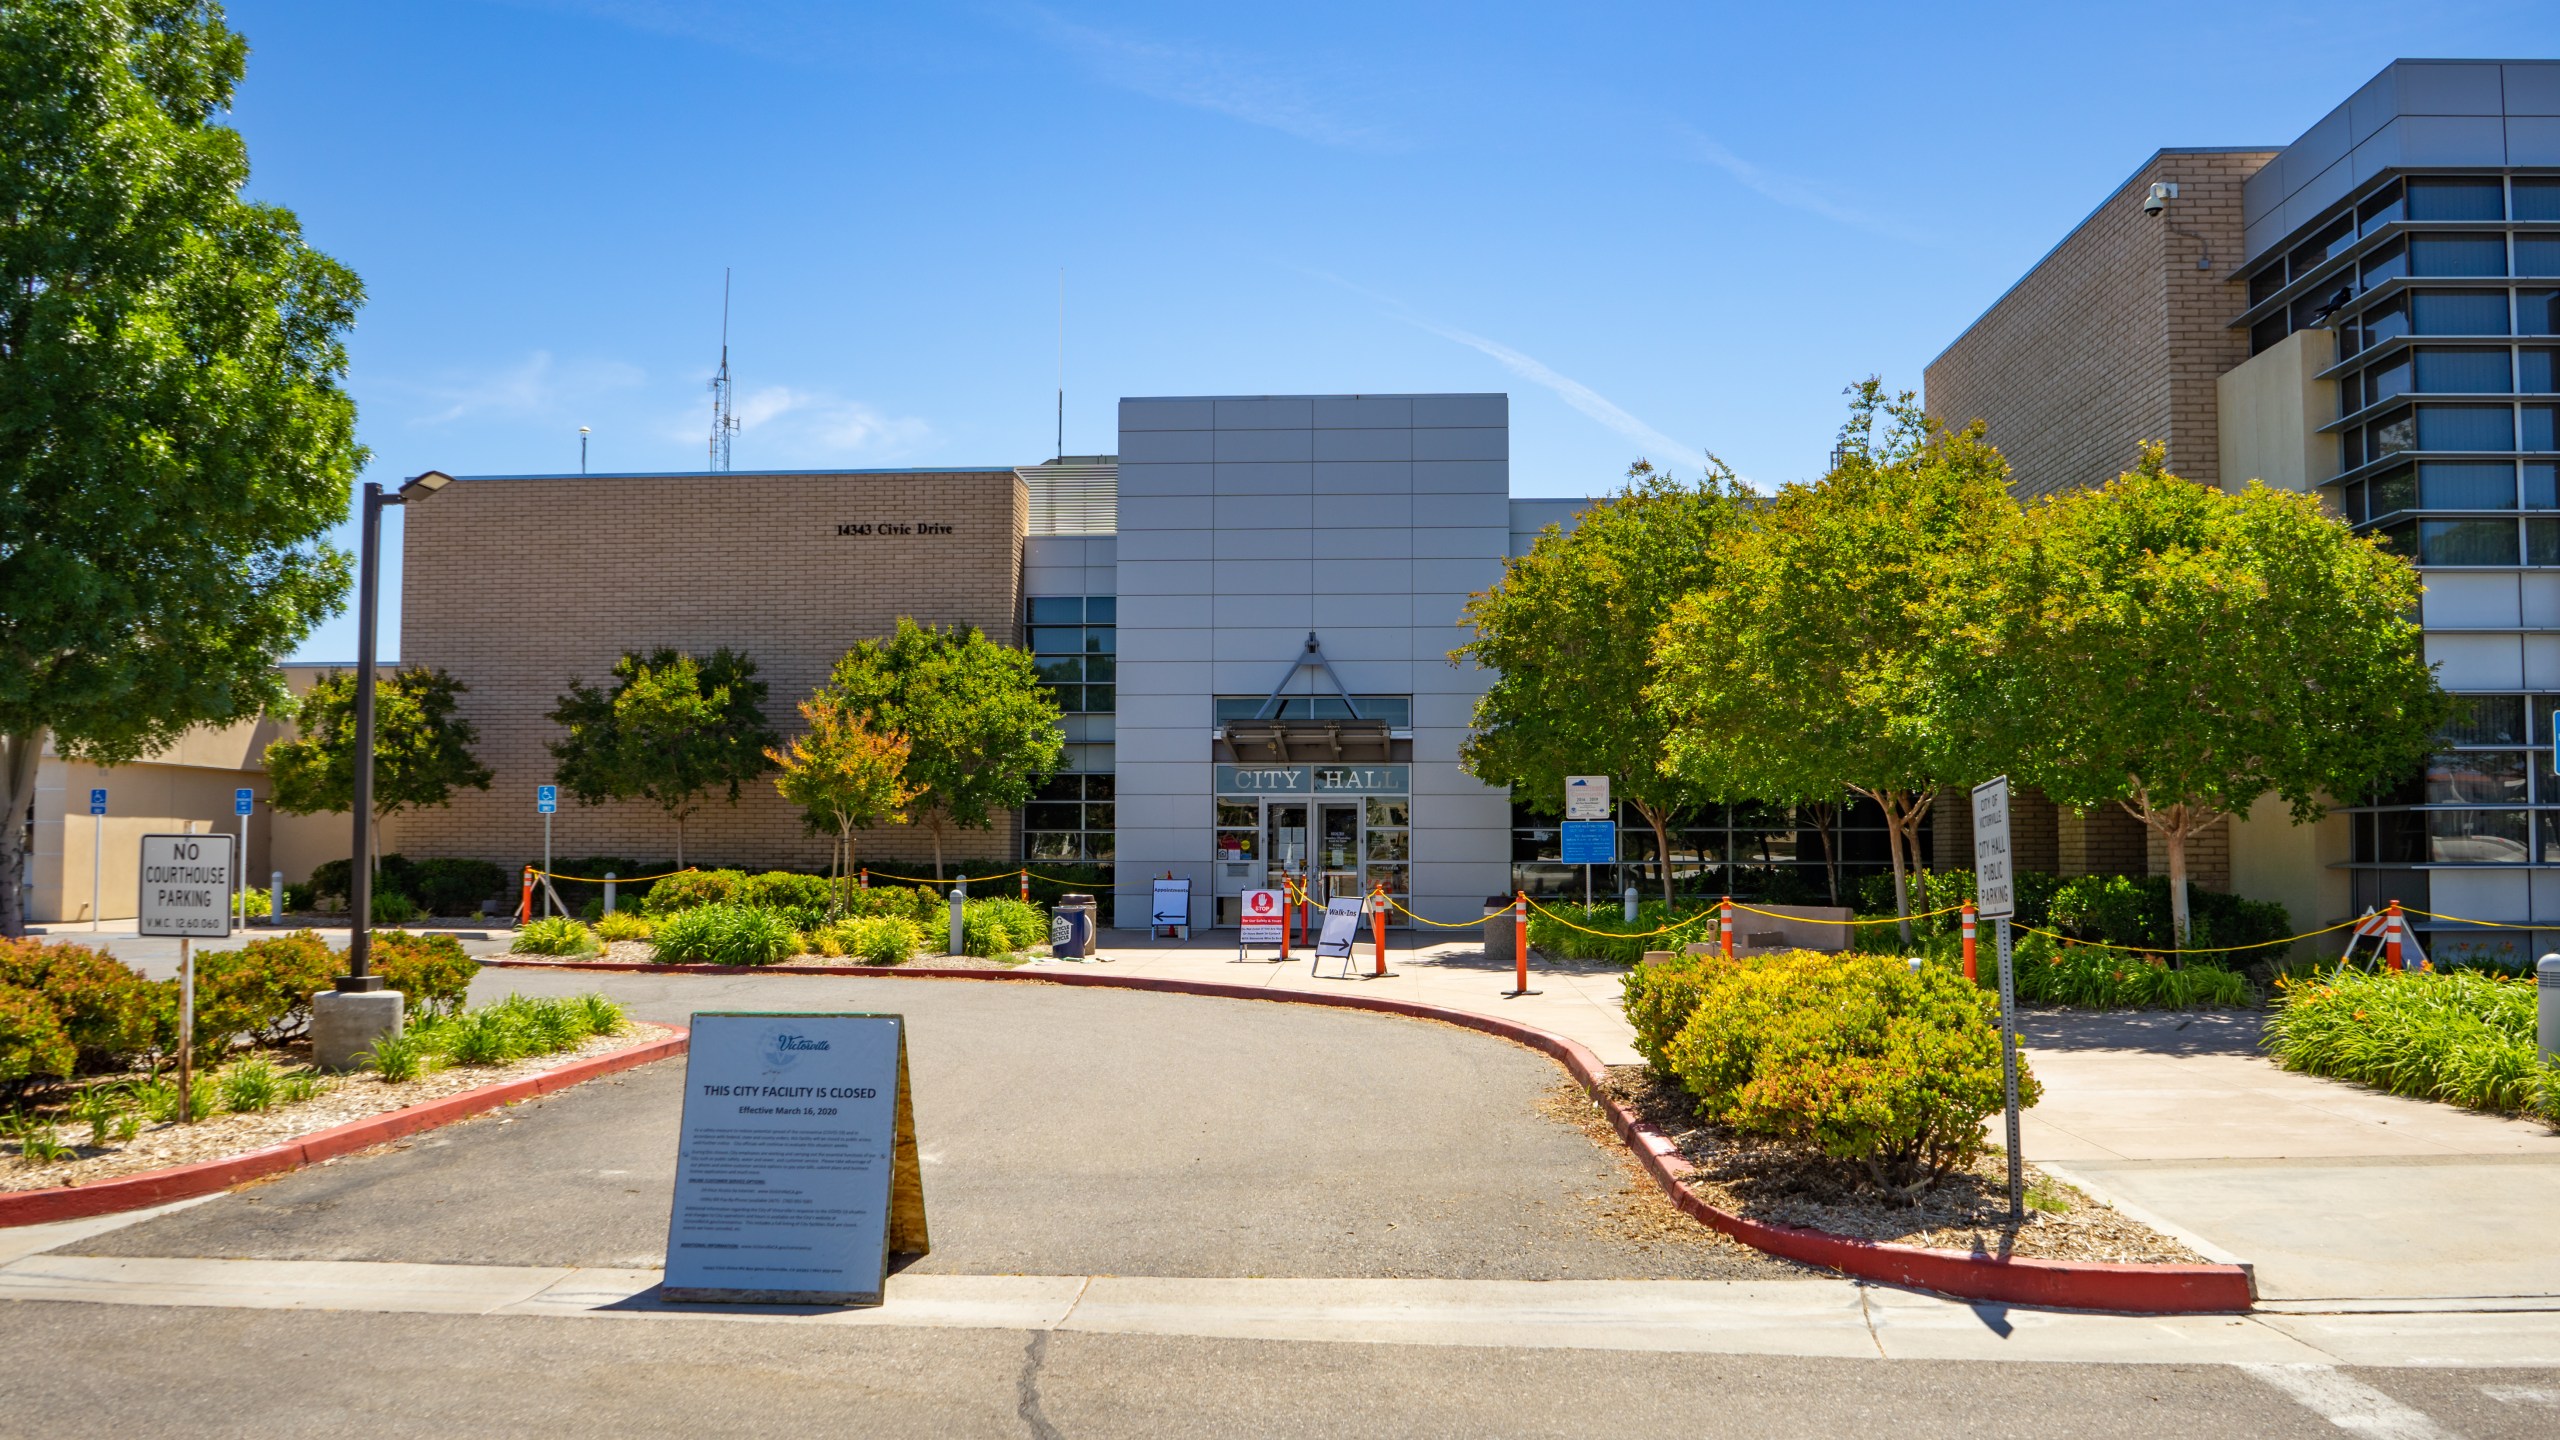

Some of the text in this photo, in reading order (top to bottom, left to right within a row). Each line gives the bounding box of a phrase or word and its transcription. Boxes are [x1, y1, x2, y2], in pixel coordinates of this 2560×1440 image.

[838, 523, 953, 535] 14343 Civic Drive
[1235, 771, 1398, 789] CITY HALL
[1981, 794, 1998, 811] CITY OF
[173, 843, 200, 860] NO
[1979, 836, 2005, 859] CITY HALL
[146, 866, 225, 884] COURTHOUSE
[1984, 862, 2003, 882] PUBLIC
[158, 890, 211, 907] PARKING
[1981, 885, 2008, 906] PARKING
[176, 918, 220, 929] 12.60.060
[778, 1035, 830, 1051] Victorville
[704, 1085, 876, 1099] THIS CITY FACILITY IS CLOSED
[738, 1106, 837, 1116] Effective March 16, 2020
